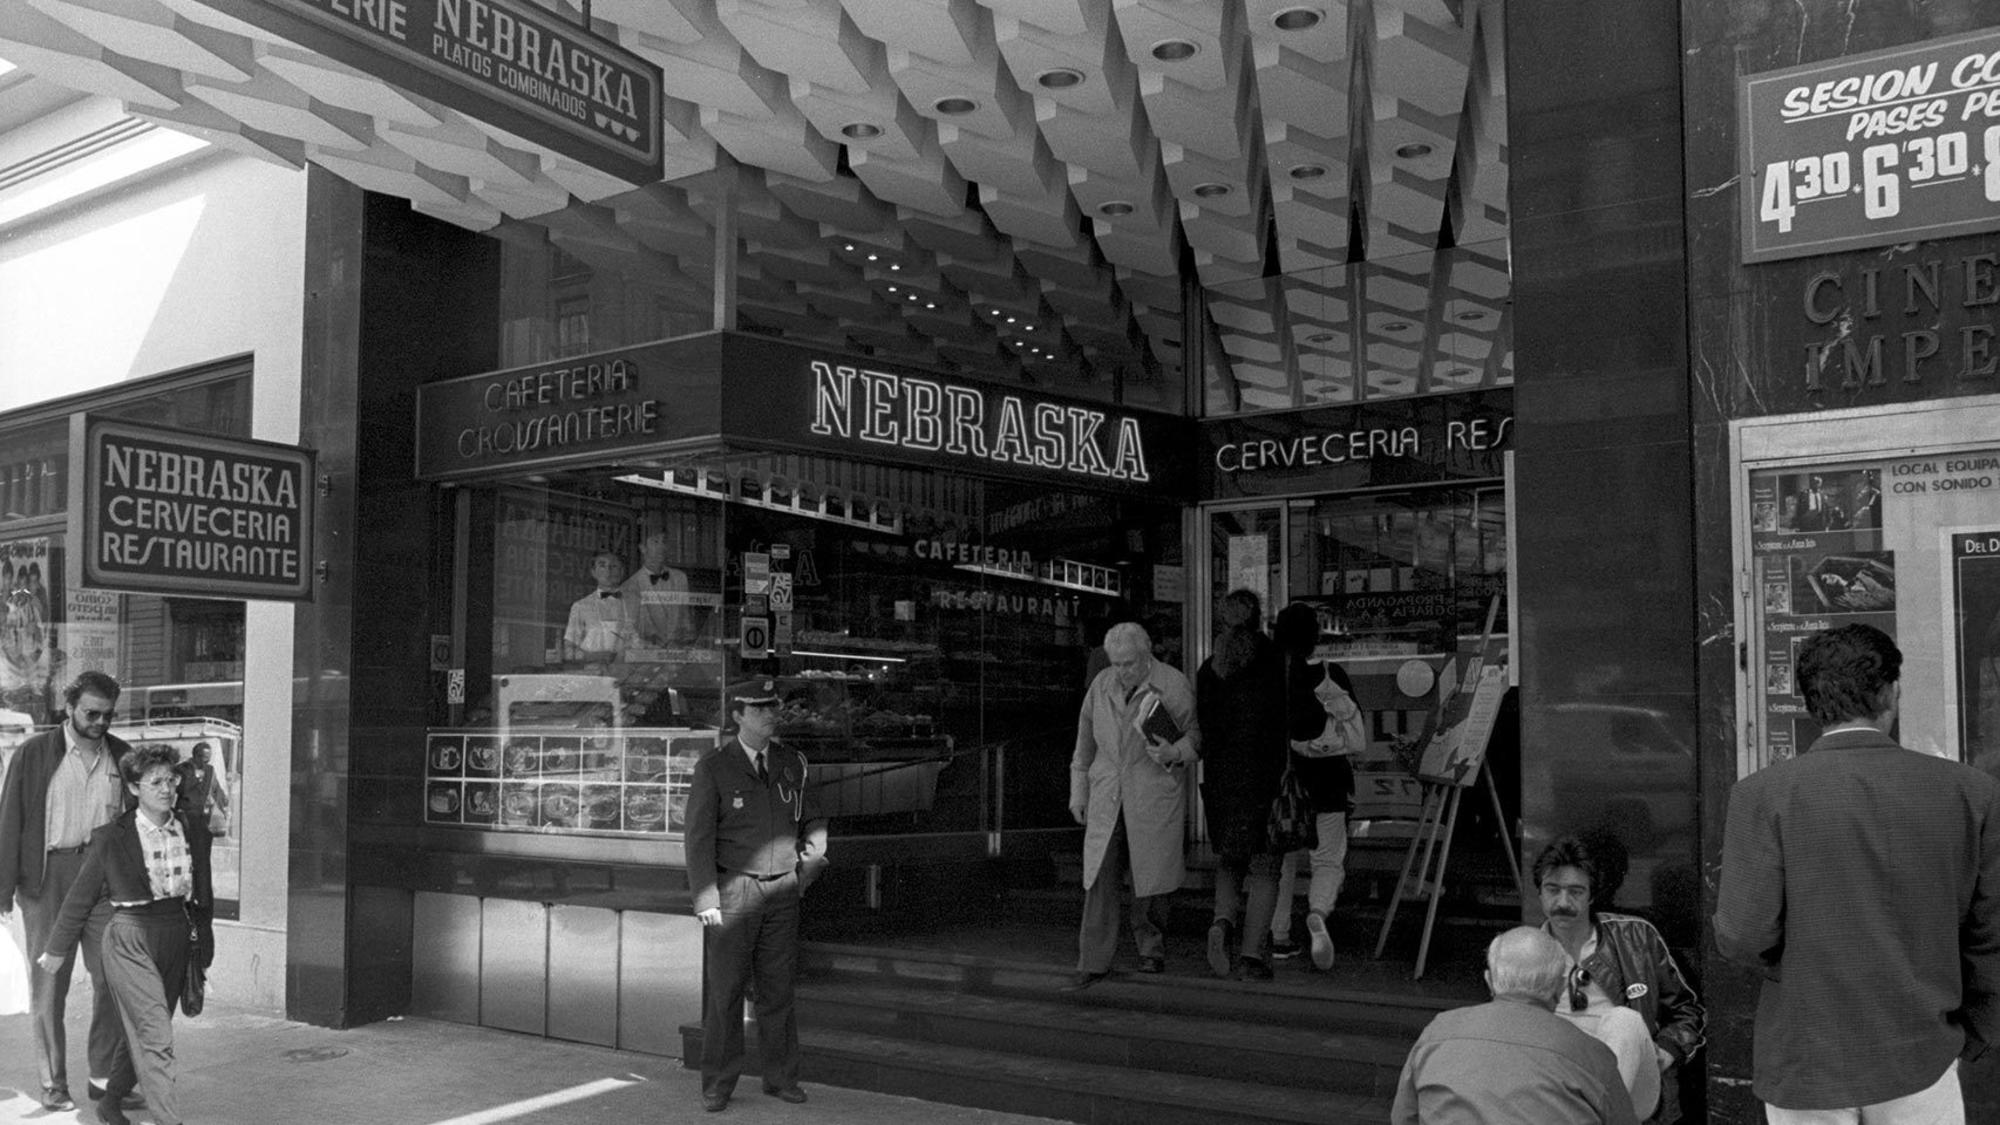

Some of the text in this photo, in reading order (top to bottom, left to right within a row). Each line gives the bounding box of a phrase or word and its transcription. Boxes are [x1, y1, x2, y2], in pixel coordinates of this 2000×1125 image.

[331, 0, 407, 41] RIE
[432, 33, 587, 121] PLATOS COMBINADOS
[433, 0, 638, 120] NEBRASKA
[1780, 62, 1938, 117] SESION
[1846, 100, 1948, 141] PASES
[1804, 253, 2000, 324] CINE
[1805, 324, 2000, 392] IMPE
[484, 360, 627, 412] CAFETERIA
[458, 400, 657, 457] CROISSANTERIE
[811, 360, 1149, 482] NEBRASKA
[1216, 426, 1419, 472] CERVECERIA
[1892, 457, 2000, 476] LOCAL EQUIPA
[104, 444, 297, 509] NEBRASKA
[1893, 476, 1992, 494] CON SONIDO
[108, 495, 290, 543] CERVECERIA
[103, 531, 297, 578] RESTAURANTE
[914, 539, 1032, 569] CAFETERIA
[940, 590, 1081, 617] RESTAURANT
